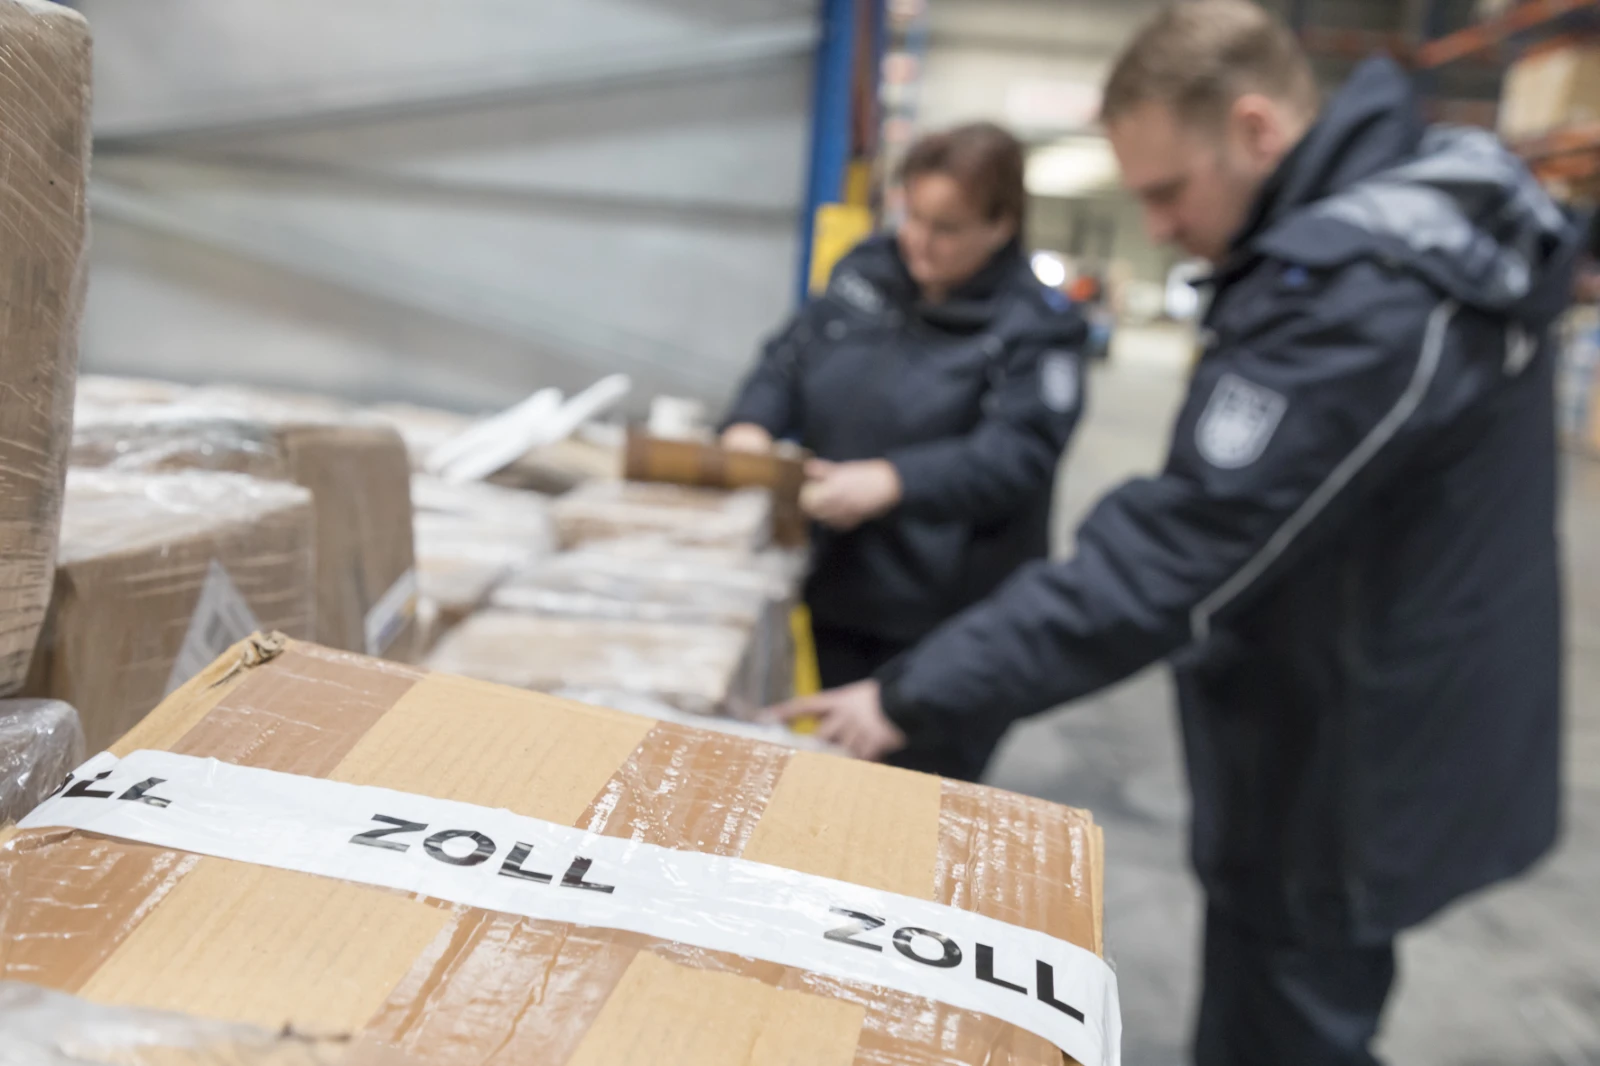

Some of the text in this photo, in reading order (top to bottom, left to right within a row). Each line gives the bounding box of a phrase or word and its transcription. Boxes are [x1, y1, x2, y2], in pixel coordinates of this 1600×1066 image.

[50, 770, 1085, 1024] LL ZOLL ZOLL
